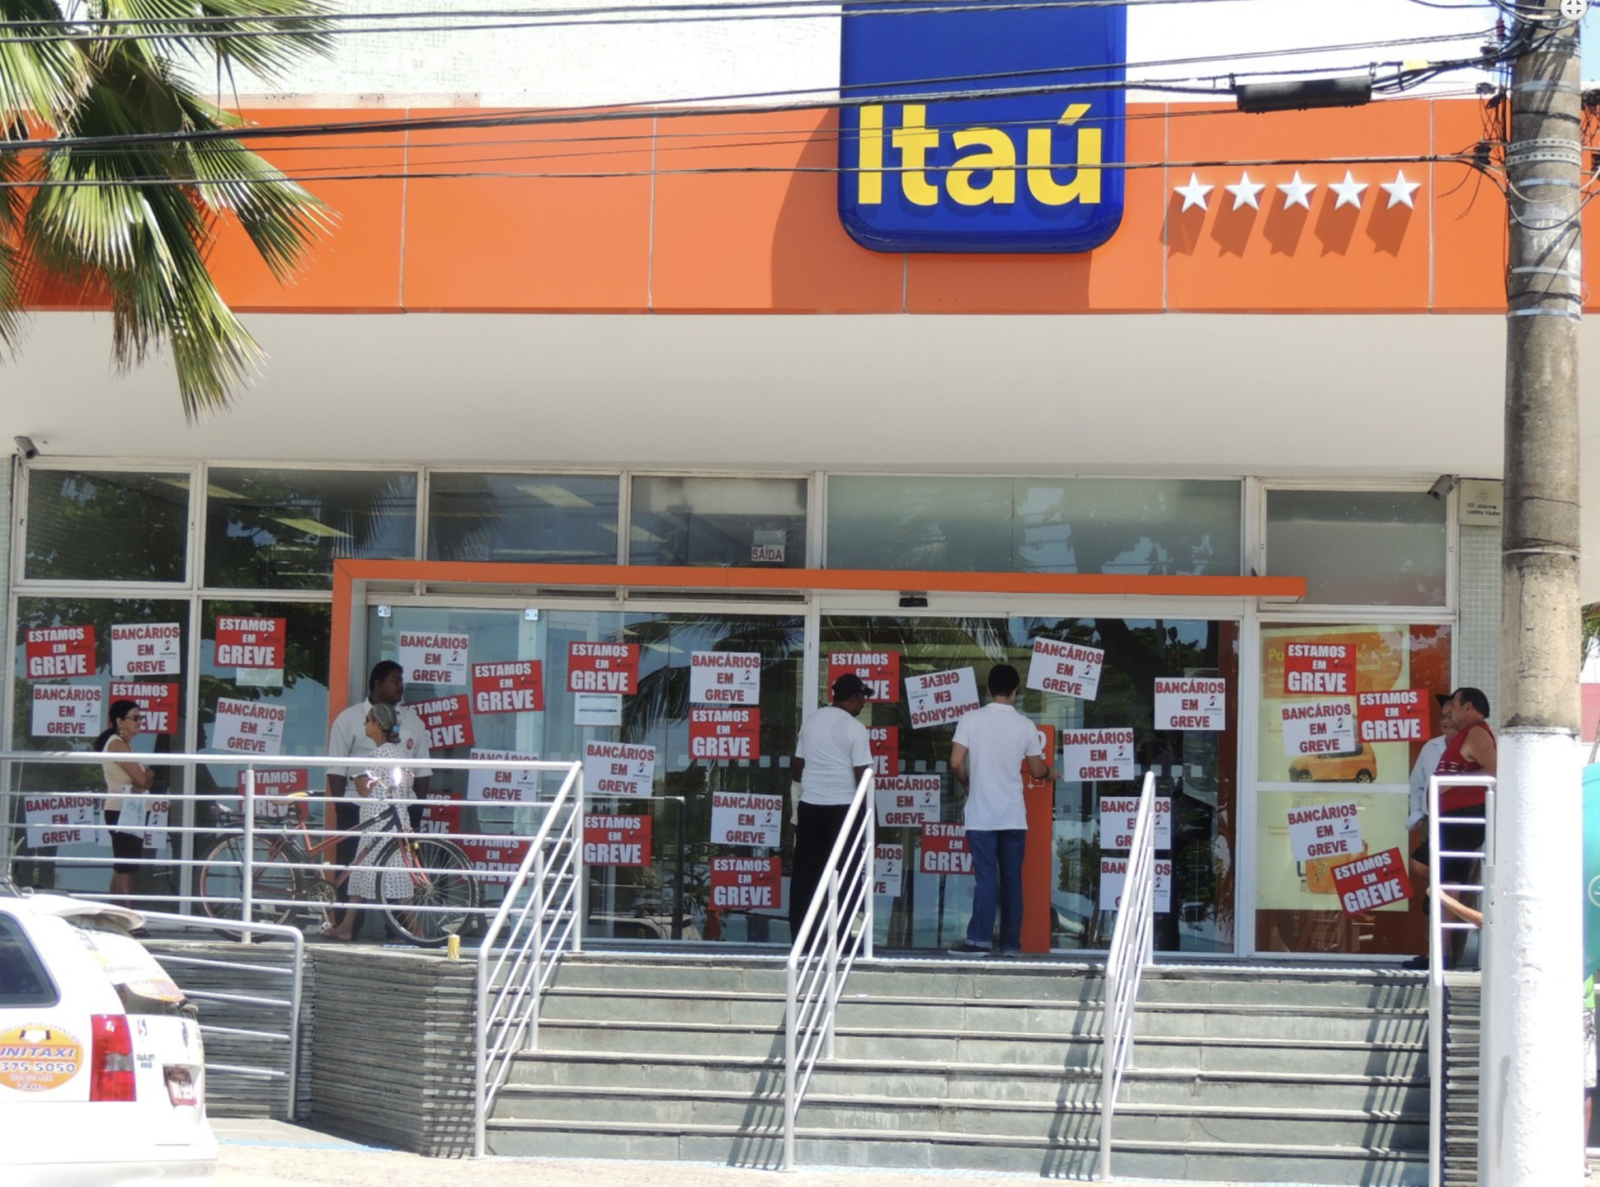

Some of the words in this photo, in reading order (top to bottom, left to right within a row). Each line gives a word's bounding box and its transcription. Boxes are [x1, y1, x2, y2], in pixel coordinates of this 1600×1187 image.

[858, 103, 1102, 206] Itaú
[752, 546, 782, 560] SAÍDA
[220, 618, 275, 632] ESTAMOS
[29, 628, 84, 642] ESTAMOS
[112, 625, 179, 640] BANCÁRIOS
[242, 634, 256, 644] EM
[53, 644, 66, 653] EM
[401, 634, 468, 650] BANCÁRIOS
[138, 645, 154, 656] EM
[218, 645, 275, 666] GREVE
[572, 644, 629, 657] ESTAMOS
[1034, 640, 1103, 665] BANCÁRIOS
[1288, 644, 1346, 658] ESTAMOS
[30, 655, 87, 676] GREVE
[424, 653, 441, 665] EM
[595, 659, 609, 669] EM
[691, 653, 760, 668] BANCÁRIOS
[832, 653, 889, 665] ESTAMOS
[1312, 660, 1327, 670] EM
[127, 661, 166, 673] GREVE
[475, 663, 532, 678] ESTAMOS
[856, 668, 870, 678] EM
[1056, 662, 1074, 677] EM
[412, 669, 452, 683] GREVE
[500, 678, 514, 688] EM
[571, 671, 629, 691] GREVE
[717, 673, 734, 684] EM
[920, 672, 960, 689] GREVE
[1288, 671, 1347, 692] GREVE
[112, 684, 168, 697] ESTAMOS
[1042, 677, 1082, 696] GREVE
[1155, 679, 1225, 694] BANCÁRIOS
[34, 687, 101, 701] BANCÁRIOS
[476, 689, 535, 712] GREVE
[705, 689, 745, 701] GREVE
[934, 690, 952, 704] EM
[1360, 691, 1418, 706] ESTAMOS
[59, 706, 75, 717] EM
[218, 702, 285, 721] BANCÁRIOS
[1181, 699, 1199, 711] EM
[1282, 703, 1351, 721] BANCÁRIOS
[692, 710, 749, 722] ESTAMOS
[1385, 708, 1399, 717] EM
[428, 715, 442, 726] EM
[1170, 715, 1210, 728] GREVE
[47, 722, 86, 734] GREVE
[240, 721, 258, 735] EM
[716, 725, 731, 734] EM
[1309, 723, 1327, 735] EM
[1362, 719, 1421, 740] GREVE
[424, 724, 465, 748] REVE
[1064, 730, 1133, 745] BANCÁRIOS
[227, 736, 267, 753] GREVE
[692, 736, 750, 757] GREVE
[1300, 738, 1340, 753] GREVE
[587, 744, 654, 761] BANCÁRIOS
[1090, 749, 1107, 761] EM
[611, 763, 628, 775] EM
[1079, 766, 1120, 779] GREVE
[241, 771, 298, 785] ETAMOS
[495, 771, 512, 783] EM
[598, 779, 638, 793] GREVE
[483, 787, 522, 801] GREVE
[713, 794, 782, 811] BANCÁRIOS
[896, 796, 914, 807] EM
[52, 814, 69, 825] EM
[738, 814, 755, 826] EM
[885, 812, 925, 825] GREVE
[1287, 803, 1357, 825] BANCÁRIOS
[584, 816, 641, 829] ESTAMOS
[42, 830, 81, 844] GREVE
[608, 832, 622, 841] EM
[726, 830, 766, 844] GREVE
[925, 824, 966, 837] ESTAM
[1316, 825, 1334, 838] EM
[949, 840, 963, 850] EM
[1307, 839, 1348, 857] GREVE
[486, 850, 500, 860] EM
[584, 843, 641, 864] GREVE
[713, 859, 771, 872] ESTAMOS
[924, 851, 974, 873] GREV
[1101, 861, 1171, 875] BANOS
[1334, 853, 1392, 880] ESTAMOS
[737, 874, 752, 884] EM
[1363, 873, 1378, 885] EM
[713, 885, 772, 906] GREVE
[1343, 878, 1404, 913] GREVE
